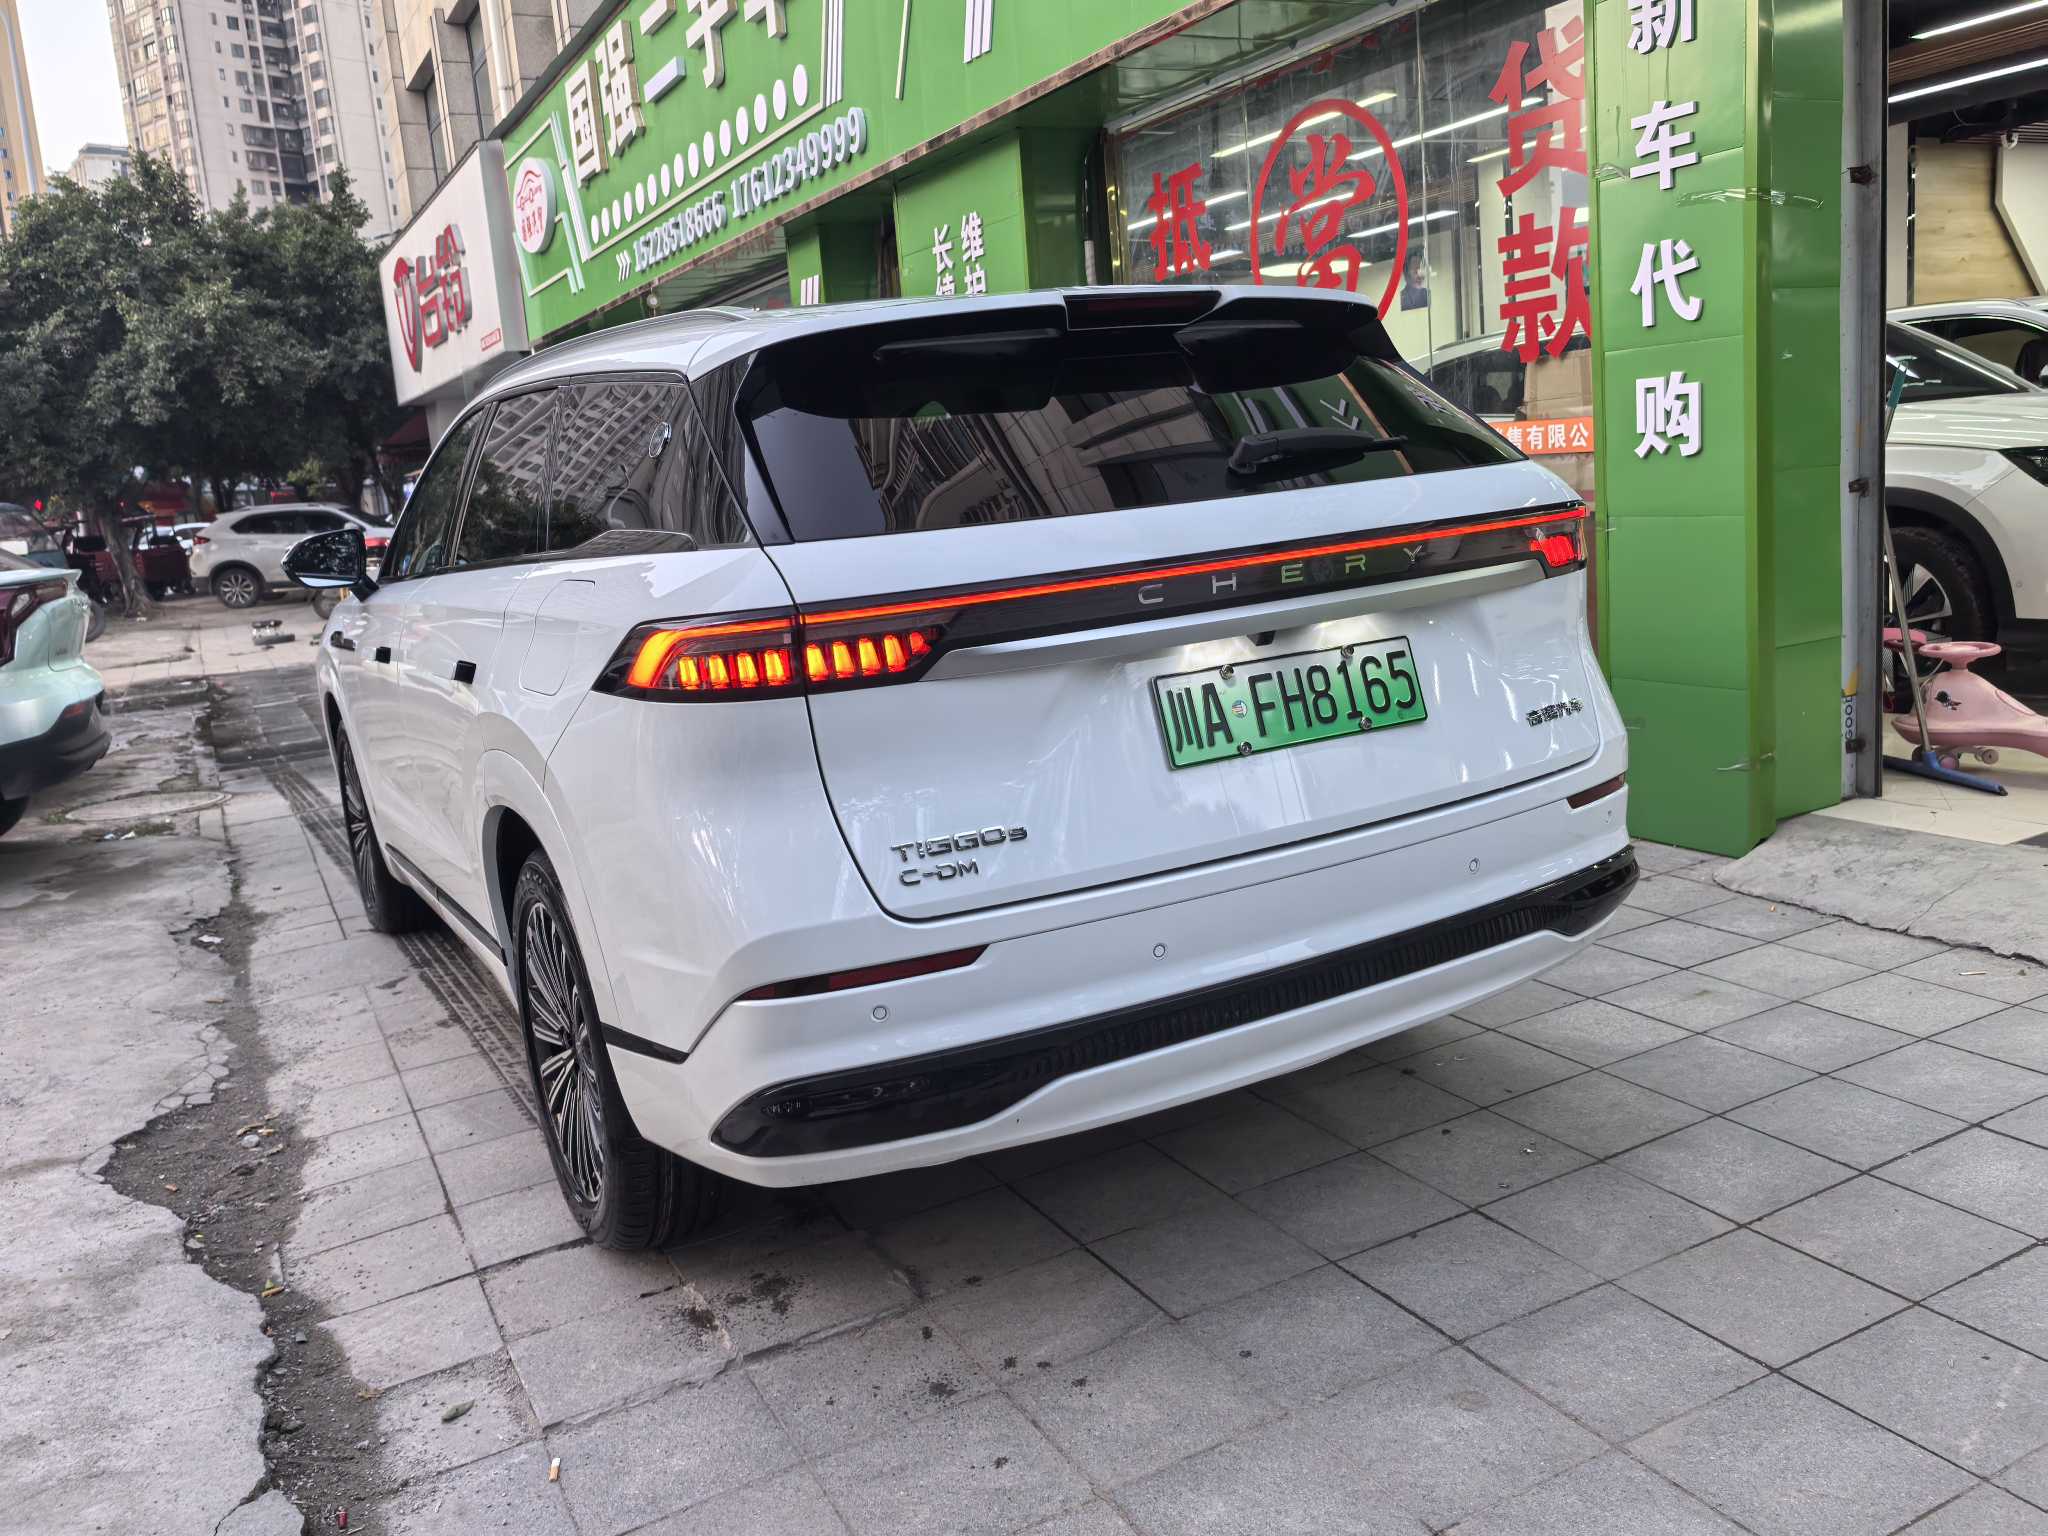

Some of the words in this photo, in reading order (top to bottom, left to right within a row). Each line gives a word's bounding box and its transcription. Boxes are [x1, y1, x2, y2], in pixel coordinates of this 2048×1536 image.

[565, 0, 787, 189] 国强二手
[633, 191, 727, 273] 15228518666
[730, 107, 868, 219] 17612349999
[1147, 162, 1212, 283] 抵
[1488, 15, 1592, 364] 贷款
[1627, 0, 1704, 460] 新车代购
[1495, 423, 1589, 450] 售有限公
[1138, 544, 1424, 605] CHERY
[899, 858, 979, 886] C-DM
